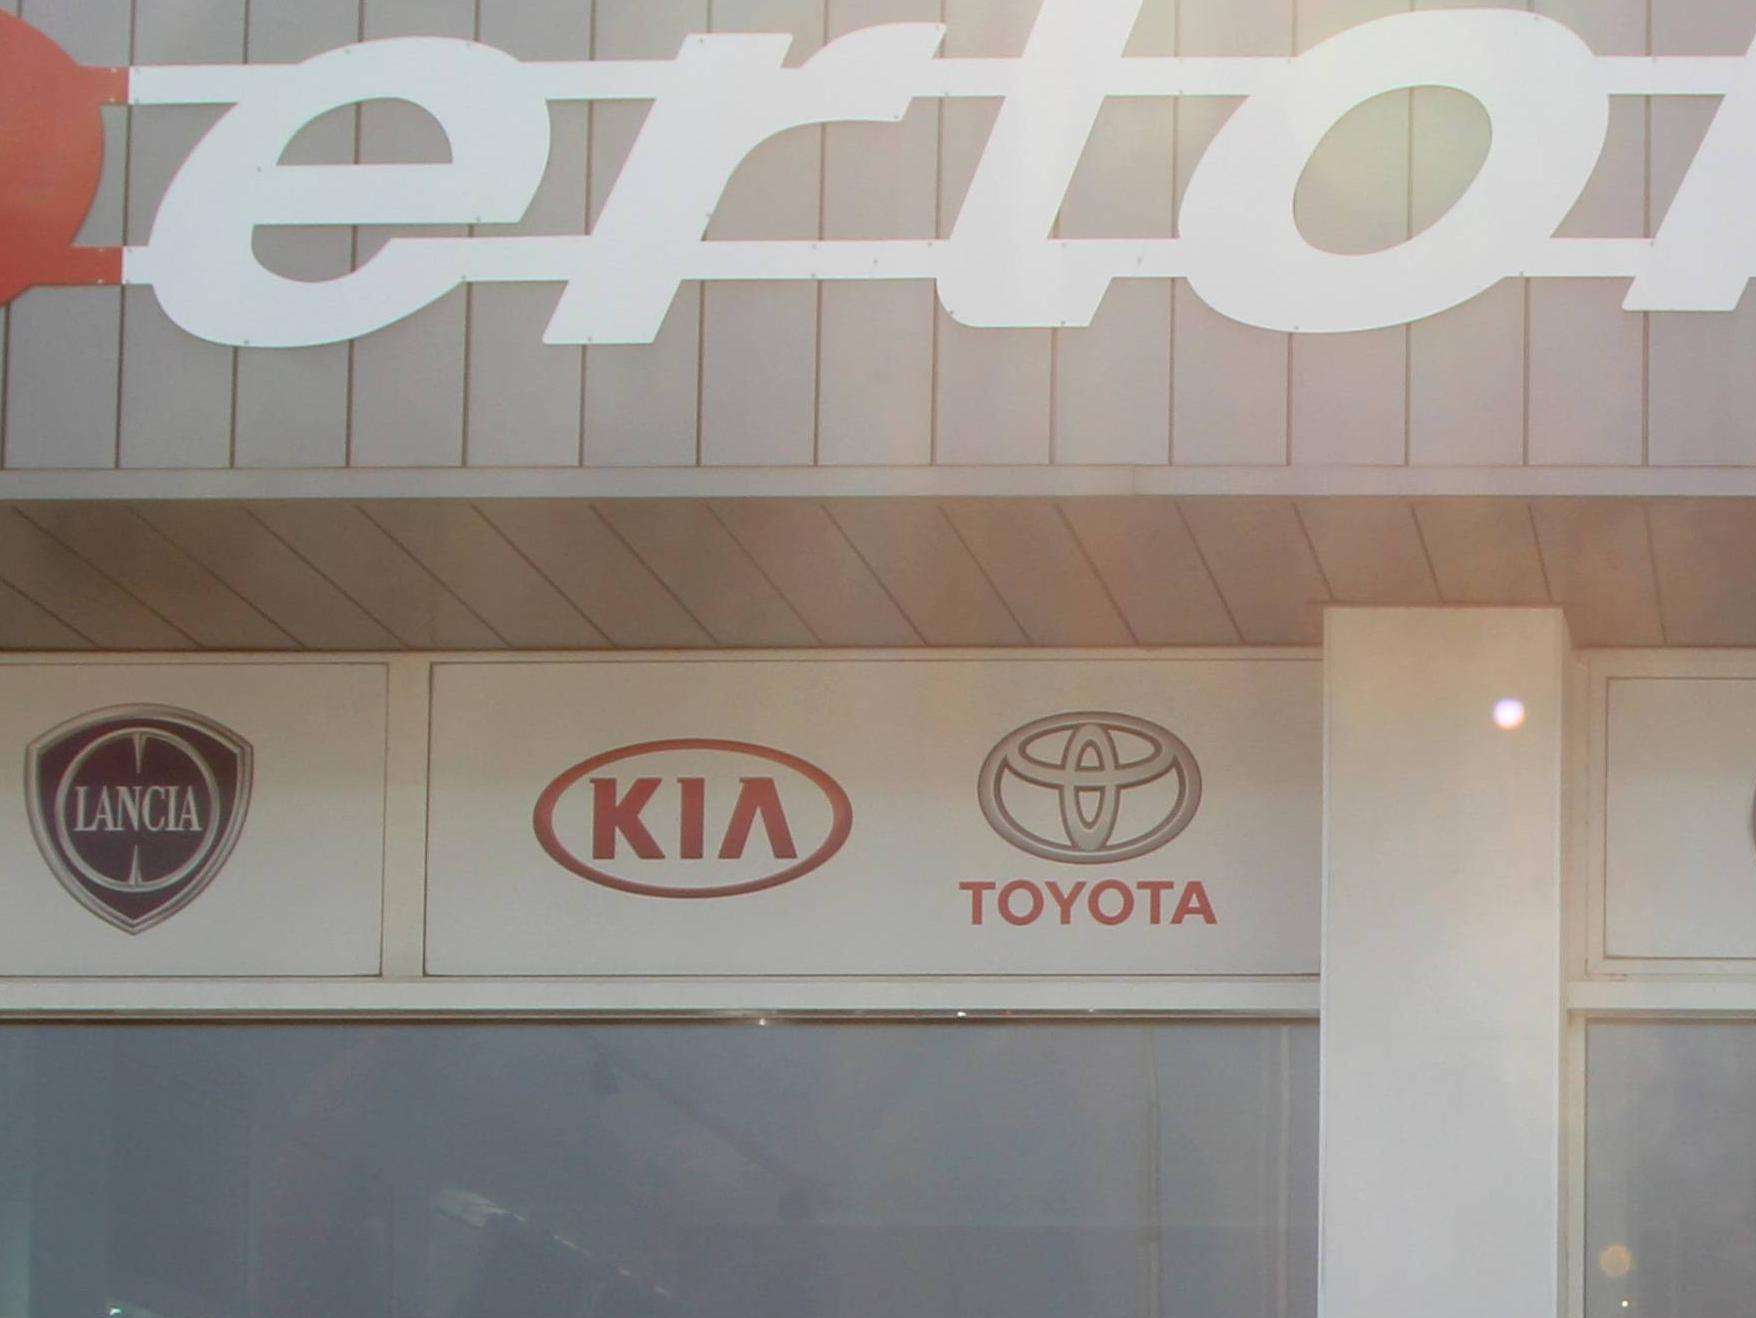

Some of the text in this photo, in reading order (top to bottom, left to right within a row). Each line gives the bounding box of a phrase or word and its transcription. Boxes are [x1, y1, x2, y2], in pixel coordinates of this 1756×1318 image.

[72, 784, 203, 834] LANCIA
[589, 776, 799, 860] KIA
[959, 880, 1217, 925] TOYOTA
